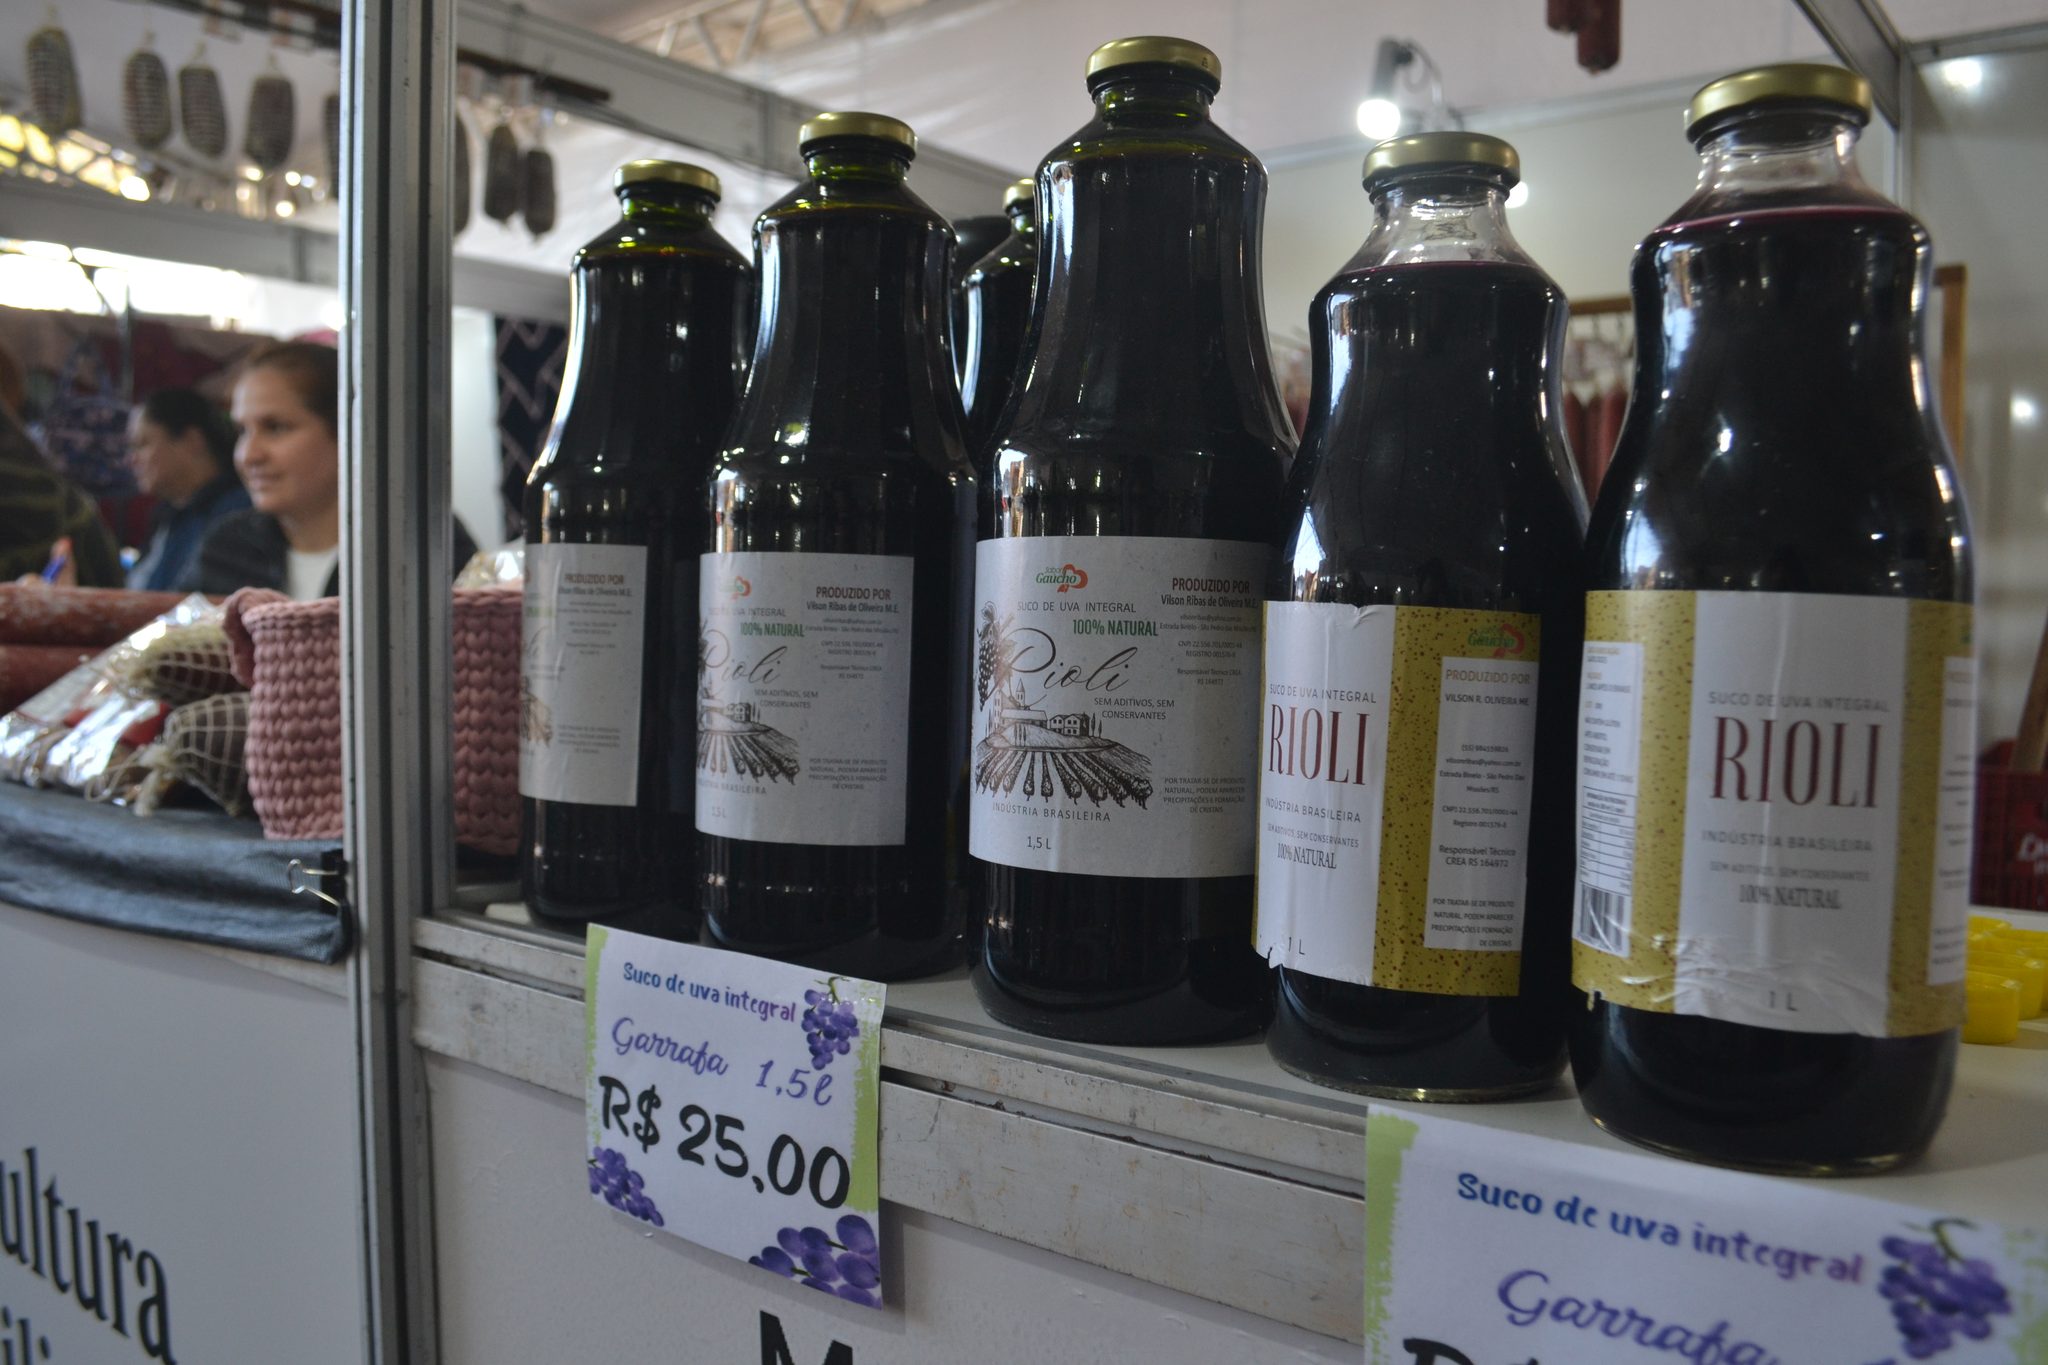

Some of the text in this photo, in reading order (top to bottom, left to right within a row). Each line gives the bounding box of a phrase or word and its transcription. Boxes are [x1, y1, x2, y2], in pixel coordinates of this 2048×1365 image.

[816, 586, 891, 600] PRODUZIDO POR
[1172, 577, 1250, 594] PRODUZIDO POR
[1017, 601, 1137, 613] SUCO DE UVA INTEGRAL
[1161, 594, 1184, 605] Vilson
[1186, 594, 1206, 607] Ribas
[1207, 595, 1217, 607] de
[1218, 596, 1243, 608] Oliveira
[748, 607, 787, 617] INTEGRAL
[740, 621, 762, 636] 100%
[763, 622, 805, 637] NATURAL
[1073, 619, 1159, 637] 100% NATURAL
[1445, 669, 1531, 685] PRODUZIDO POR
[1269, 683, 1377, 704] SUCO DE UVA INTEGRAL
[1445, 694, 1475, 703] VILSON
[1484, 696, 1517, 705] OLIVEIRA
[1708, 691, 1891, 714] SUCO DE UVA INTEGRAL
[1093, 697, 1175, 709] SEM ADITIVOS, SEM
[1102, 710, 1166, 720] CONSERVANTES
[1268, 703, 1371, 786] RIOLI
[1710, 715, 1884, 808] RIOLI
[992, 802, 1111, 822] INDÚSTRIA BRASILEIRA
[1265, 797, 1362, 823] INDÚSTRIA BRASILEIRA
[1027, 836, 1052, 850] 1,5 L
[1296, 830, 1309, 840] SEM
[1309, 832, 1360, 849] CONSERVANTES
[1701, 830, 1873, 851] INDÚSTRIA BRASILEIRA
[1293, 846, 1338, 870] NATURAL
[1439, 845, 1488, 856] Responsável
[1445, 857, 1467, 866] CREA
[1468, 858, 1478, 867] RS
[1773, 886, 1843, 910] NATURAL
[1299, 938, 1306, 955] L
[623, 963, 797, 1023] Suco de uva integral
[1786, 992, 1798, 1011] L
[611, 1017, 729, 1076] Garrafa
[599, 1075, 851, 1209] R$ 25,00
[1457, 1172, 1864, 1282] Suco de uva integral
